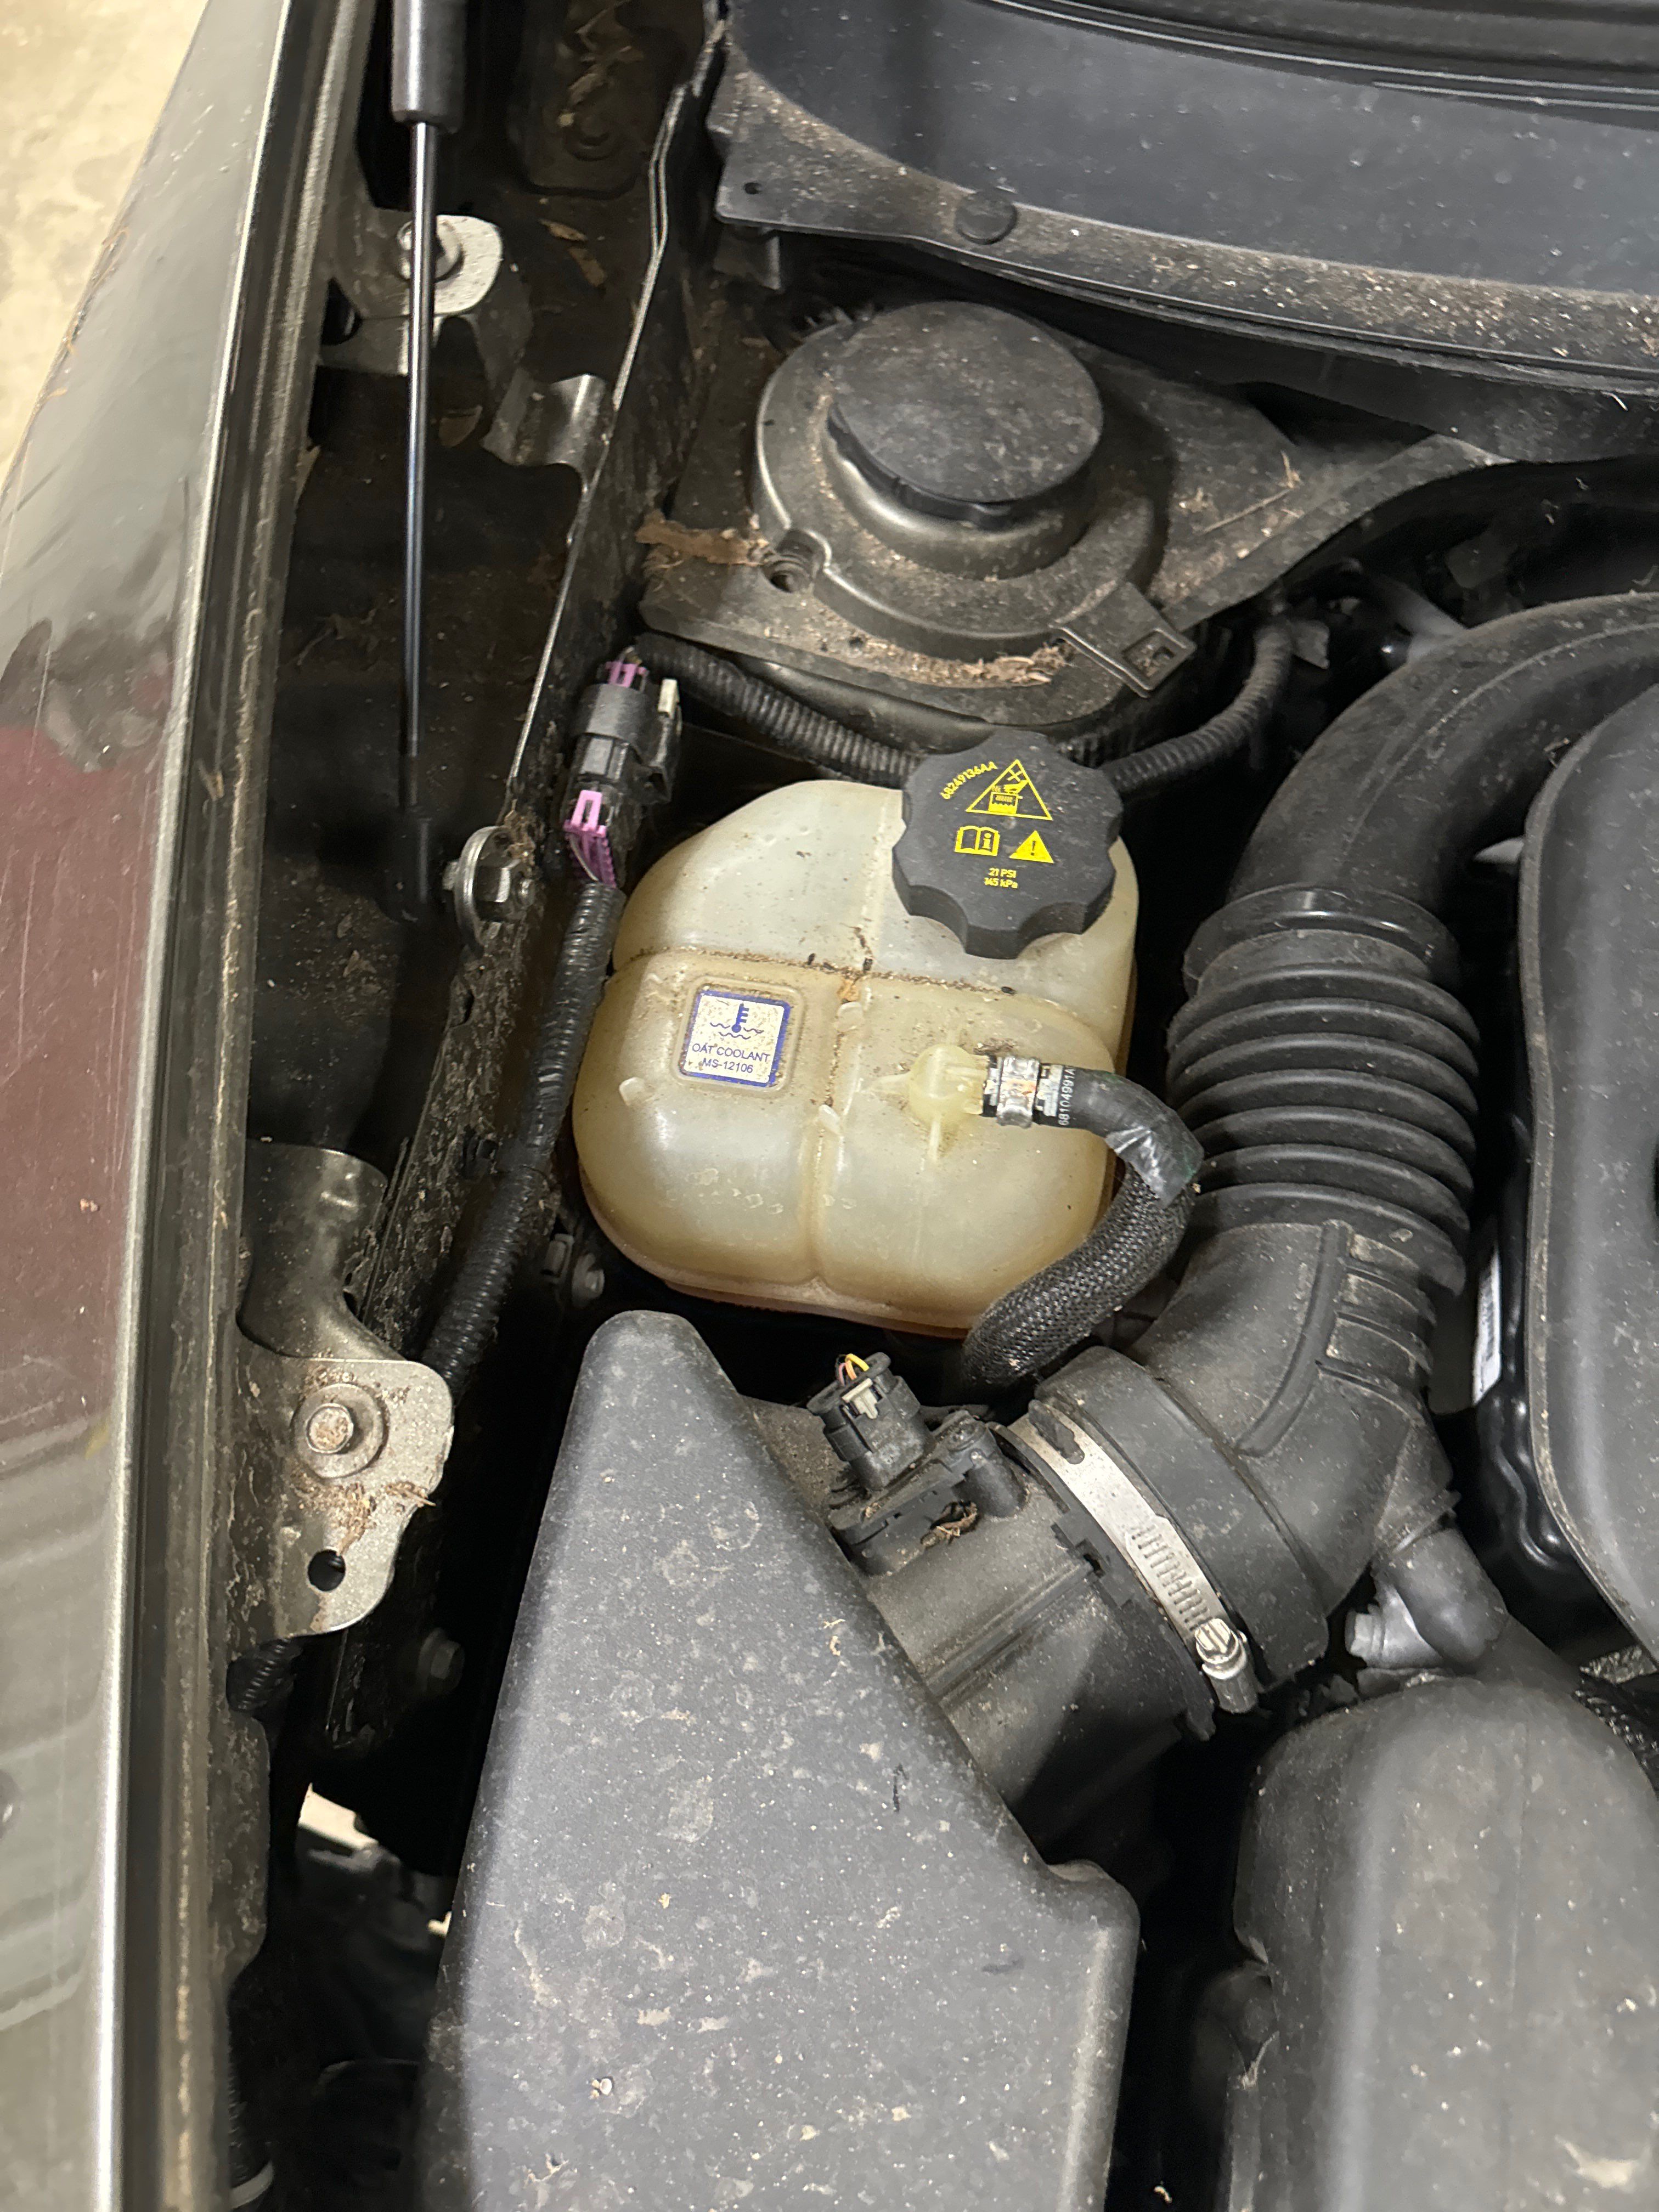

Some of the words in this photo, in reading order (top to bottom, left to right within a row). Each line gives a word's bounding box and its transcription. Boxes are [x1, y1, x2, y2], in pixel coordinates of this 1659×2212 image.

[940, 760, 997, 799] 68249136AA
[988, 867, 1000, 877] 21
[1000, 868, 1017, 878] PSI
[1000, 879, 1018, 889] kPa
[692, 1042, 715, 1054] OAT
[716, 1047, 770, 1063] COOLANT
[702, 1057, 754, 1073] MS-12106
[1058, 1066, 1076, 1126] 68104991A
